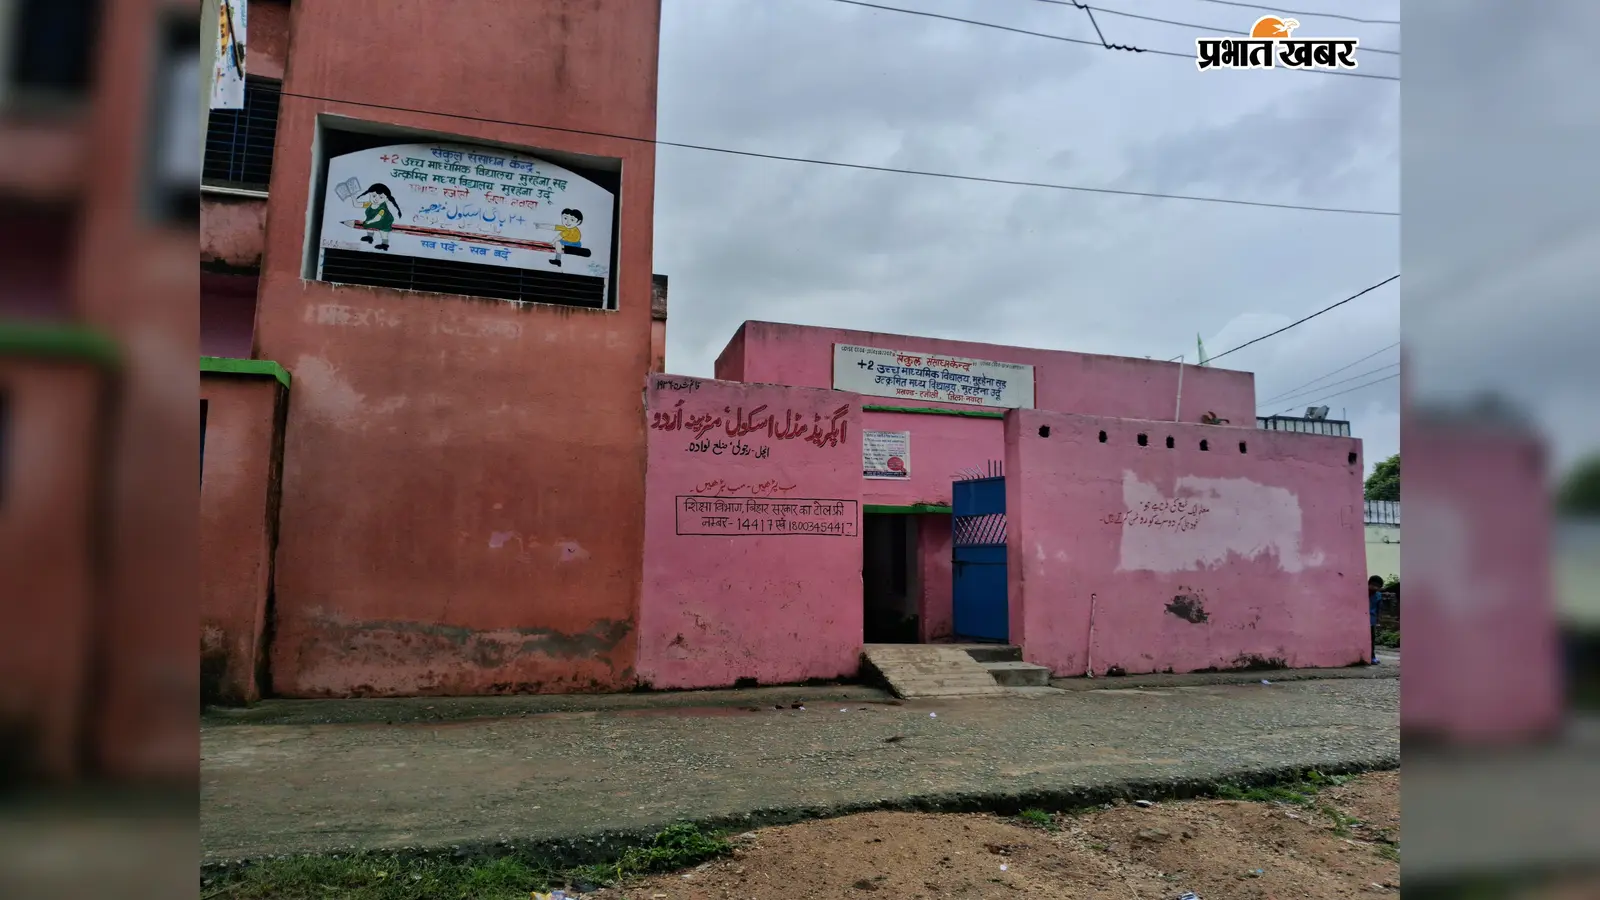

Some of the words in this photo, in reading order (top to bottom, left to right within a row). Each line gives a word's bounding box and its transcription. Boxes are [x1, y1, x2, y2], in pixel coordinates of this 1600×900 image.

[430, 146, 463, 162] संकुल
[468, 149, 506, 167] संसाधन
[509, 155, 535, 173] केन्द्र
[379, 154, 400, 165] +2
[401, 156, 426, 168] उच्च
[427, 160, 471, 174] माध्यमिक
[475, 164, 515, 181] विद्यालय
[552, 177, 568, 193] सह
[431, 173, 457, 185] मध्य
[458, 174, 495, 191] विद्यालय
[421, 240, 437, 250] सब
[469, 245, 490, 256] सब
[857, 359, 875, 371] +2
[876, 363, 901, 375] उच्च
[901, 366, 940, 379] माध्यमिक
[995, 379, 1008, 390] सह
[909, 377, 927, 388] मध्य
[774, 408, 808, 440] مڈل
[712, 440, 728, 455] ضلع
[683, 497, 713, 513] शिक्षा
[745, 499, 770, 515] बिहार
[771, 502, 799, 518] सरकार
[799, 504, 813, 516] का
[813, 500, 832, 516] टोल
[832, 501, 845, 517] फ्री
[737, 518, 773, 532] 14417
